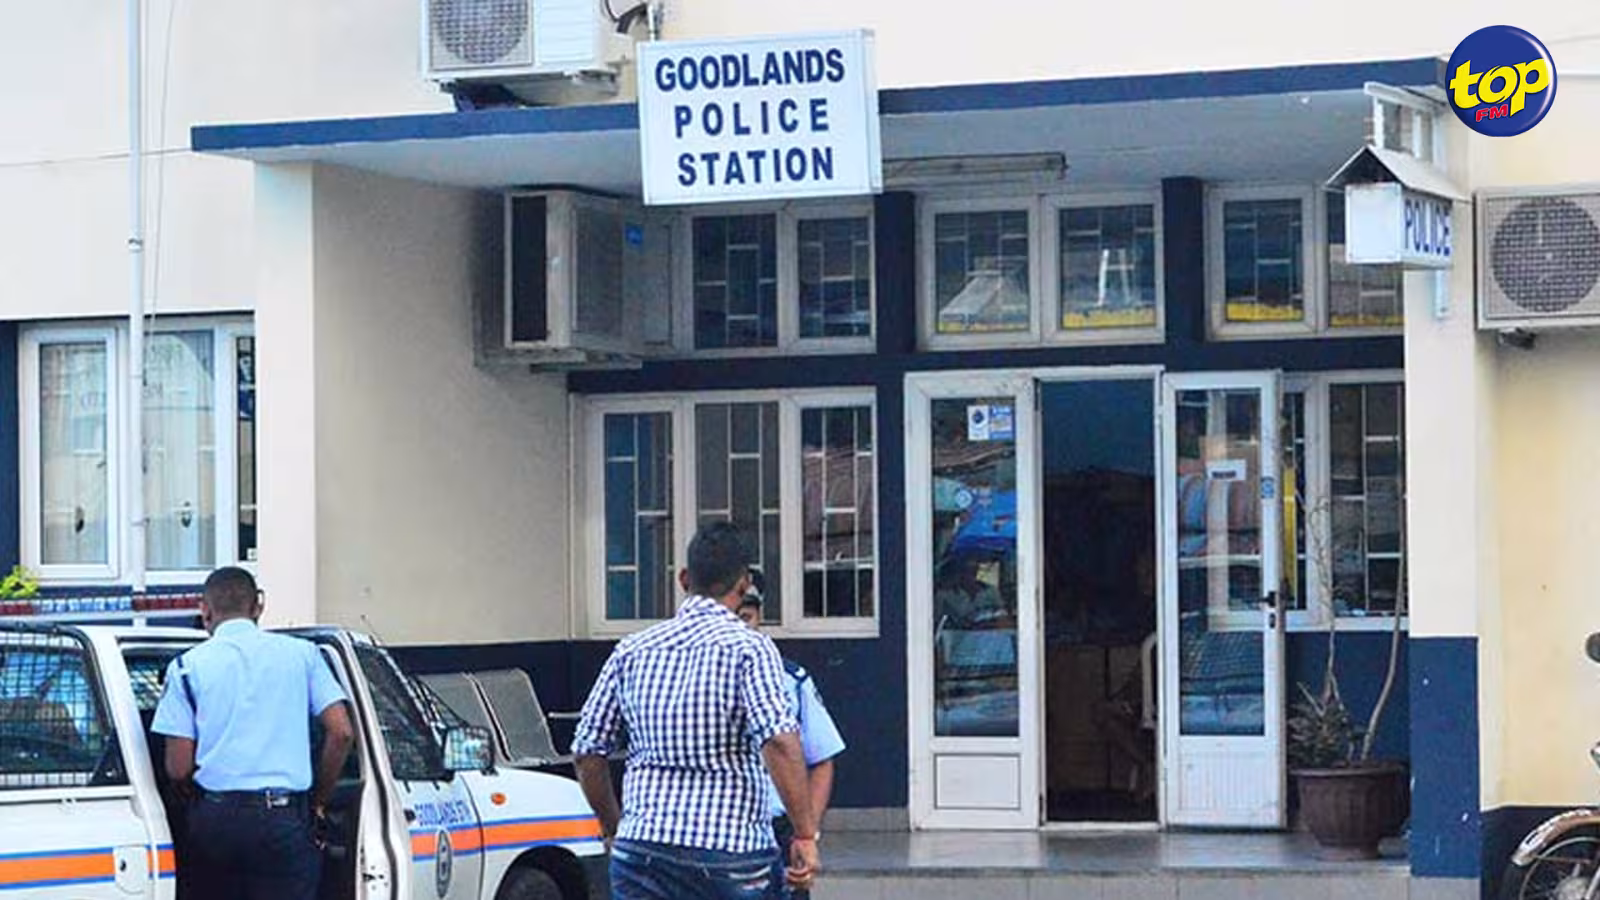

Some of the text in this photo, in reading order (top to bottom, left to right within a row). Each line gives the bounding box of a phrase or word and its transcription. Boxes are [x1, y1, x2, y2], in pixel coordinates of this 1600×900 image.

[655, 48, 845, 92] GOODLANDS
[674, 98, 829, 139] POLICE
[678, 147, 834, 187] STATION
[1404, 199, 1451, 257] POLICE
